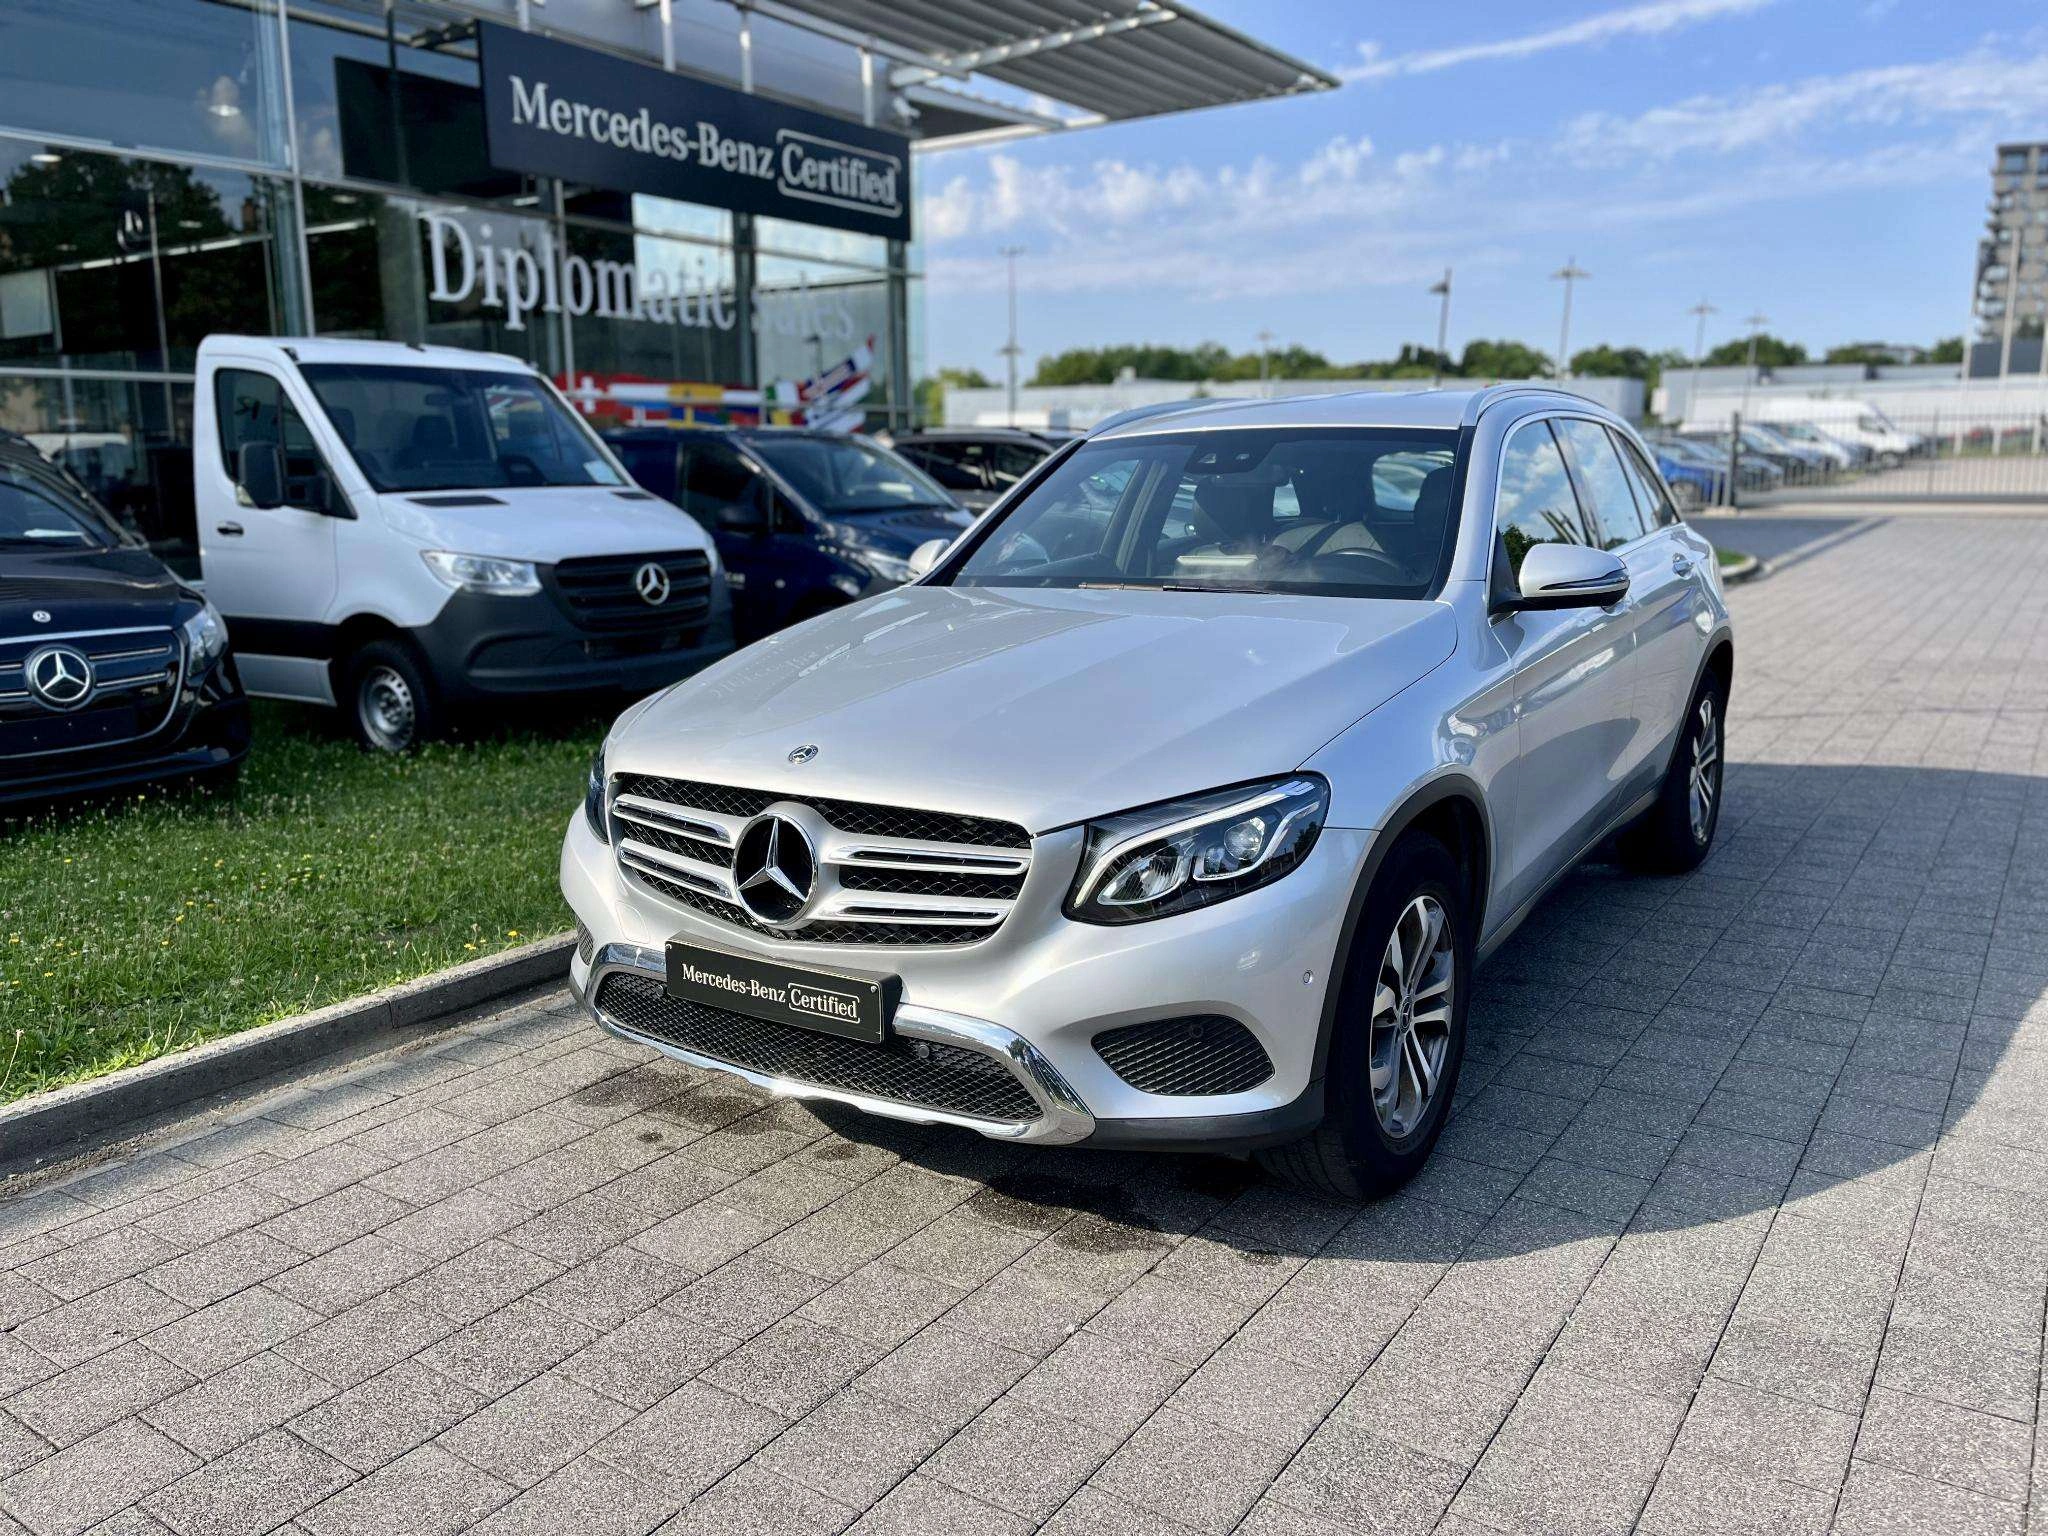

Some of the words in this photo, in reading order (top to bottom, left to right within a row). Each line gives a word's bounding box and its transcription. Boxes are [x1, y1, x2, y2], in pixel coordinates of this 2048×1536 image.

[509, 75, 775, 180] Mercedes-Benz
[781, 141, 897, 206] Certified
[428, 213, 737, 332] Diplomatic
[682, 963, 786, 1004] Mercedes-Benz
[790, 987, 858, 1019] Certified
